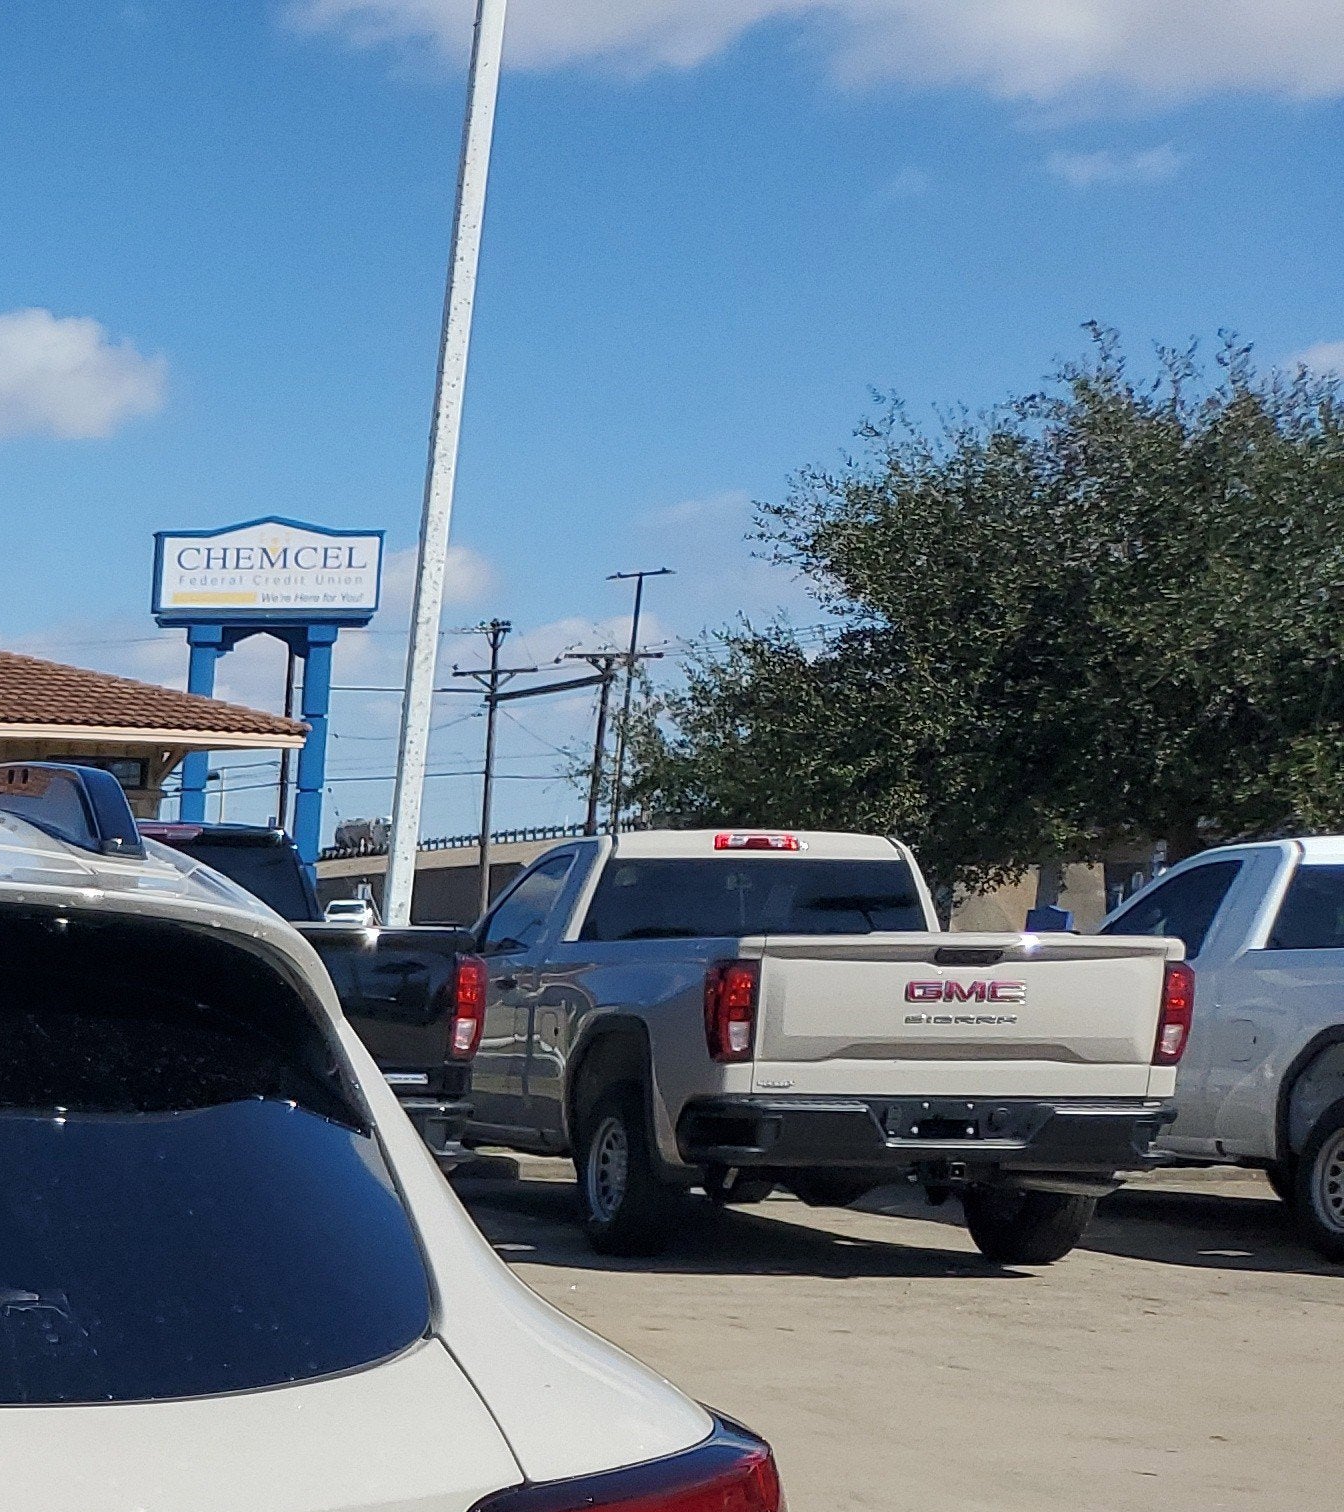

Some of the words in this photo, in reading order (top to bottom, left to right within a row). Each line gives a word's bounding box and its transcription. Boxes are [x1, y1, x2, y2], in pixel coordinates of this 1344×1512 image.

[177, 546, 367, 571] CHEMCEL
[179, 575, 243, 586] Federal
[253, 574, 305, 586] Credit
[315, 574, 364, 586] Union
[904, 979, 1027, 1003] GMC
